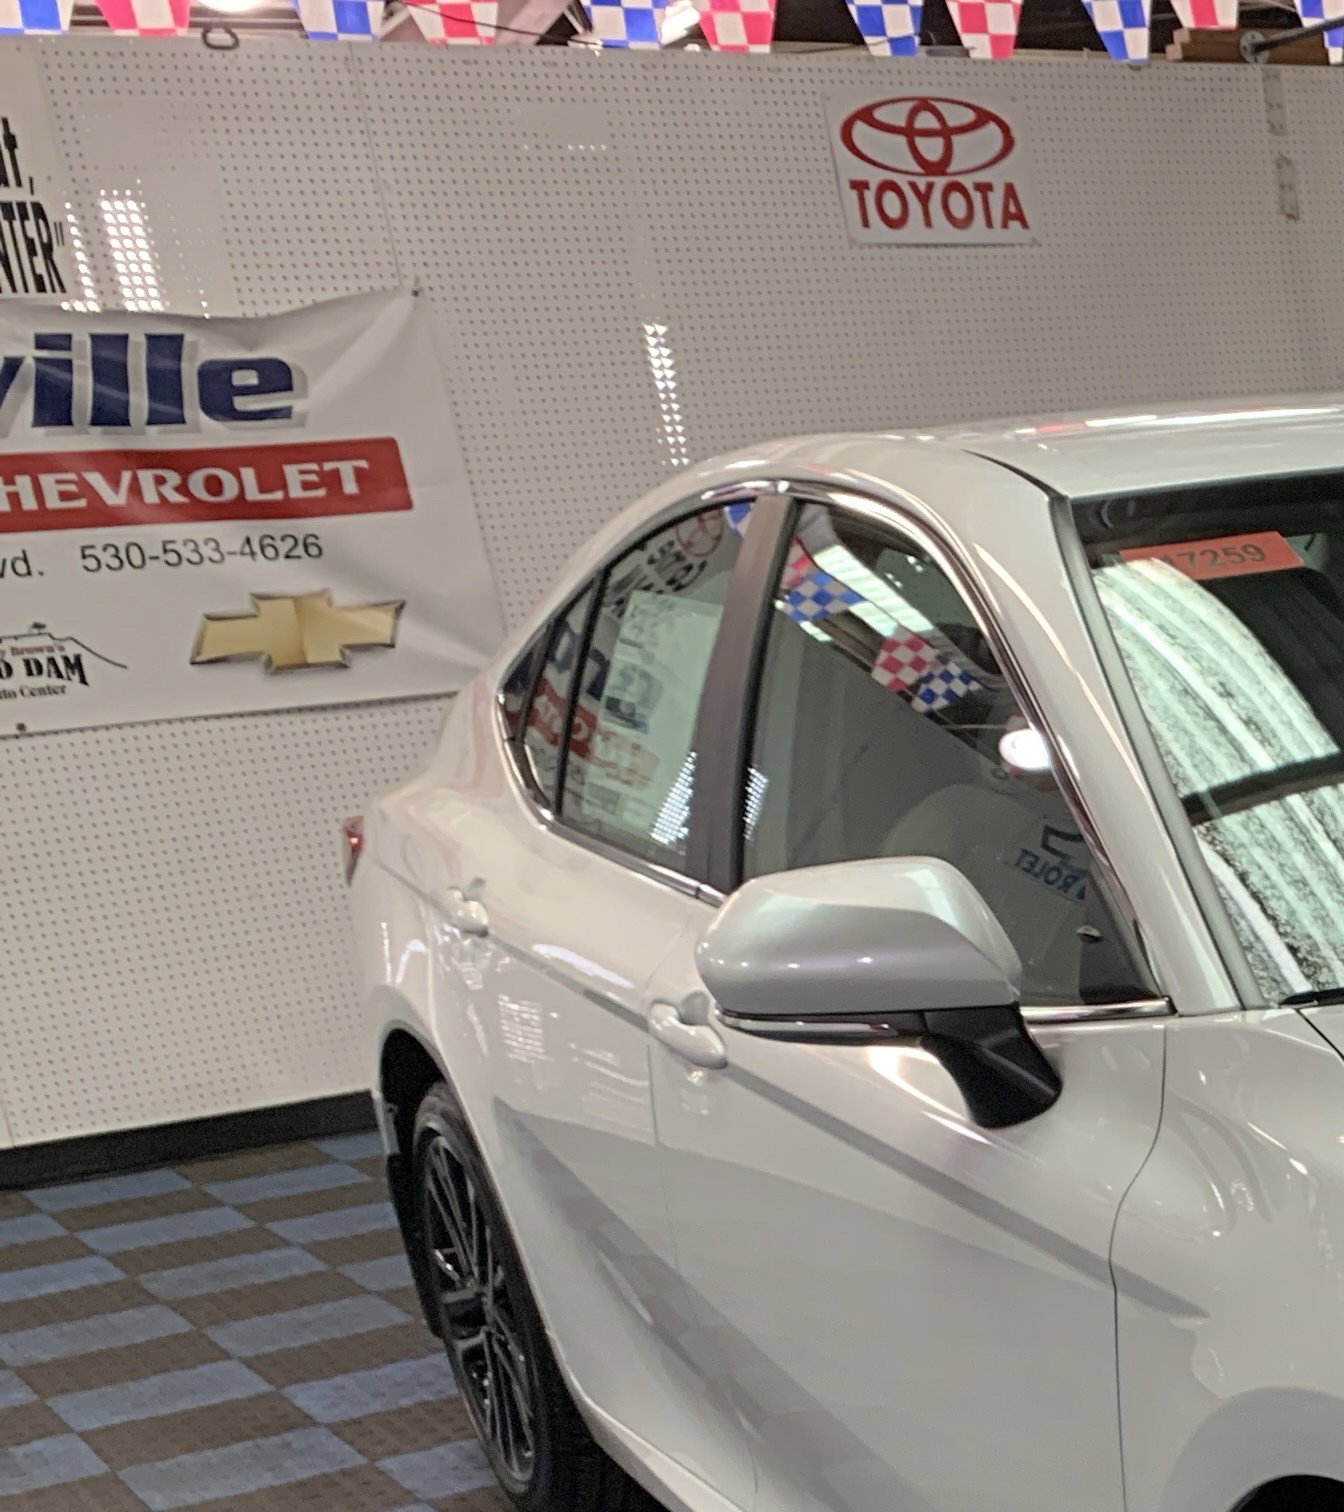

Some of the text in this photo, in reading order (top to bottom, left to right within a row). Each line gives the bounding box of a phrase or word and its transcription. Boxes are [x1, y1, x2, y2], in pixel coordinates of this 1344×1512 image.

[848, 178, 1030, 231] TOYOTA
[80, 534, 324, 573] 530-533-4626
[22, 653, 90, 687] DAM
[19, 684, 67, 698] Center
